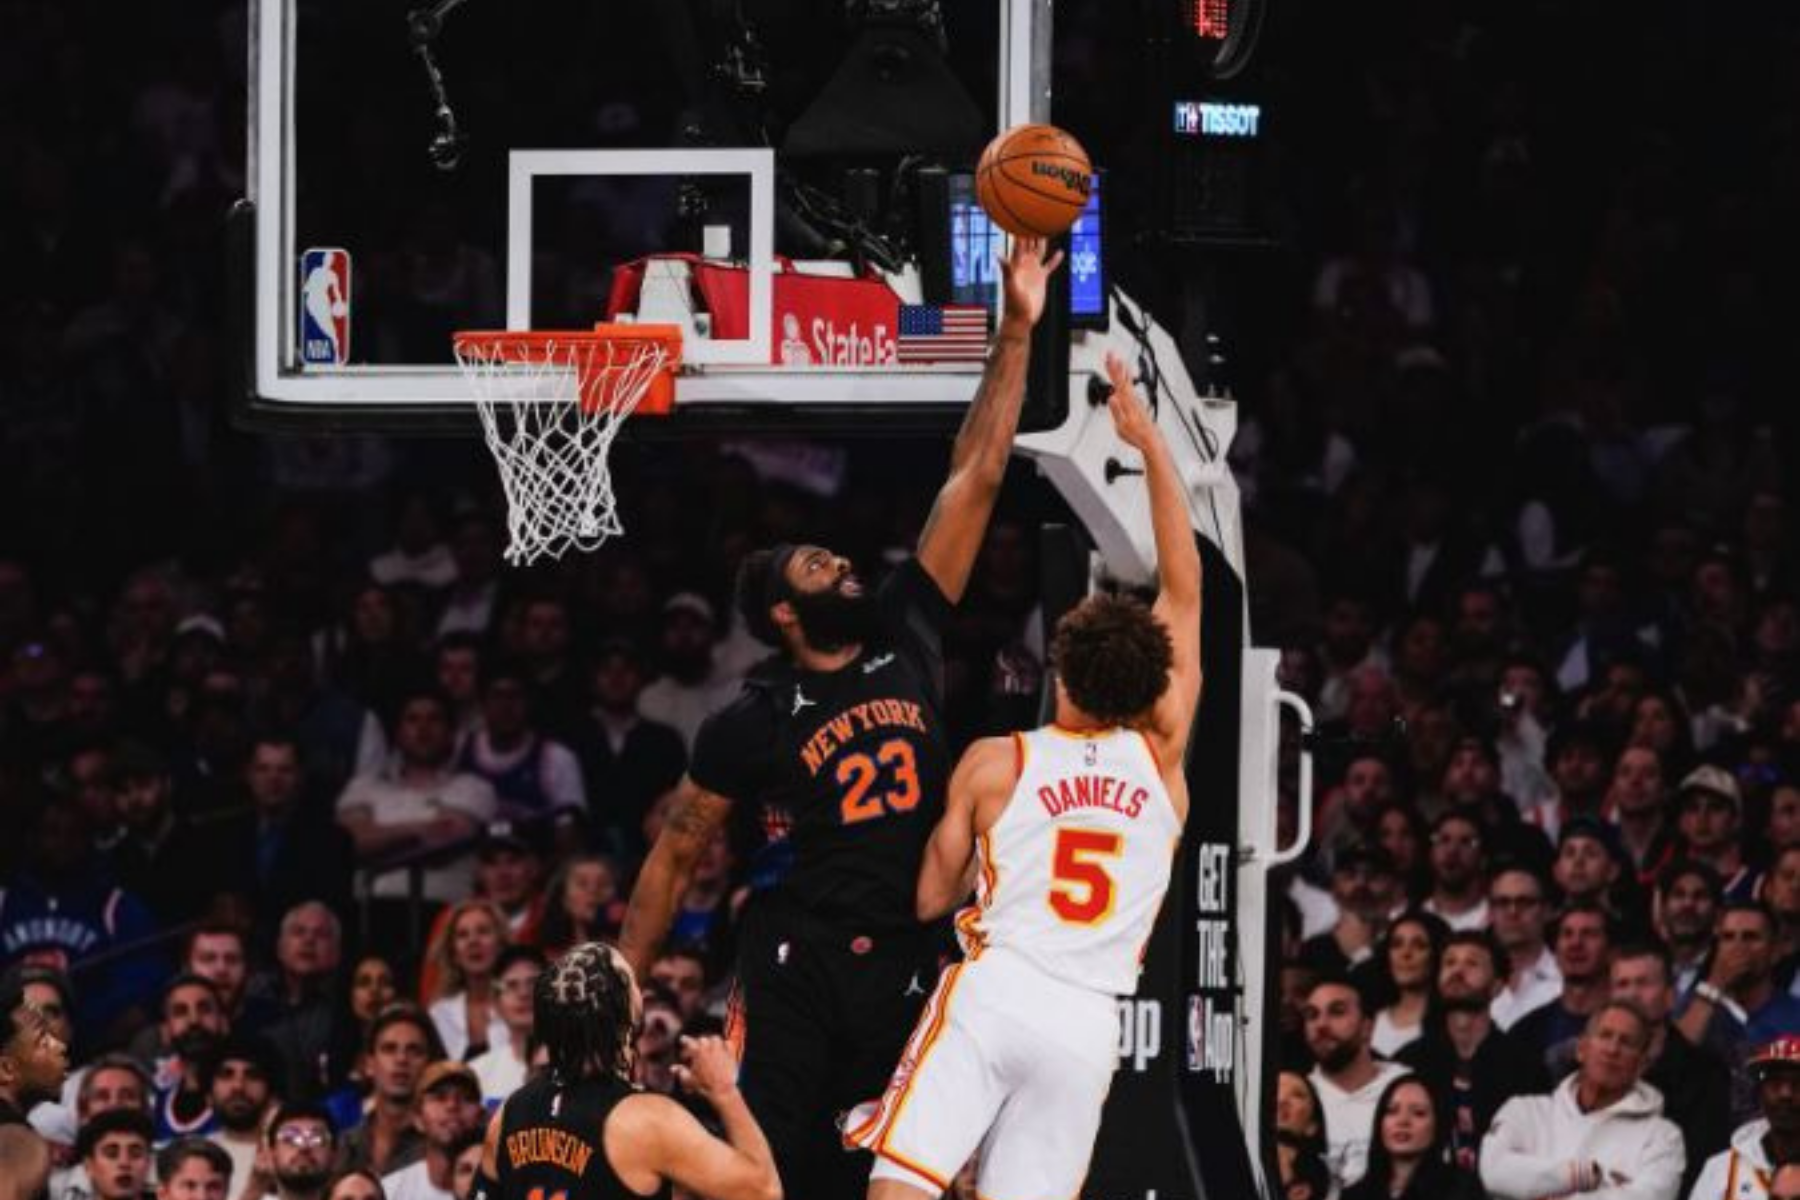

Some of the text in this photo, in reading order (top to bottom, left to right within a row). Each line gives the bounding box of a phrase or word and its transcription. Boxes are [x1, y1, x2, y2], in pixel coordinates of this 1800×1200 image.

[1200, 103, 1260, 137] TISSOT
[306, 339, 331, 359] NBA
[812, 318, 873, 366] State
[800, 699, 926, 778] NEW YORK
[836, 738, 921, 824] 23
[1037, 776, 1149, 819] DANIELS
[1047, 824, 1125, 928] 5
[1198, 843, 1230, 912] GET
[1197, 920, 1230, 988] THE
[506, 1128, 593, 1178] BRUNSON
